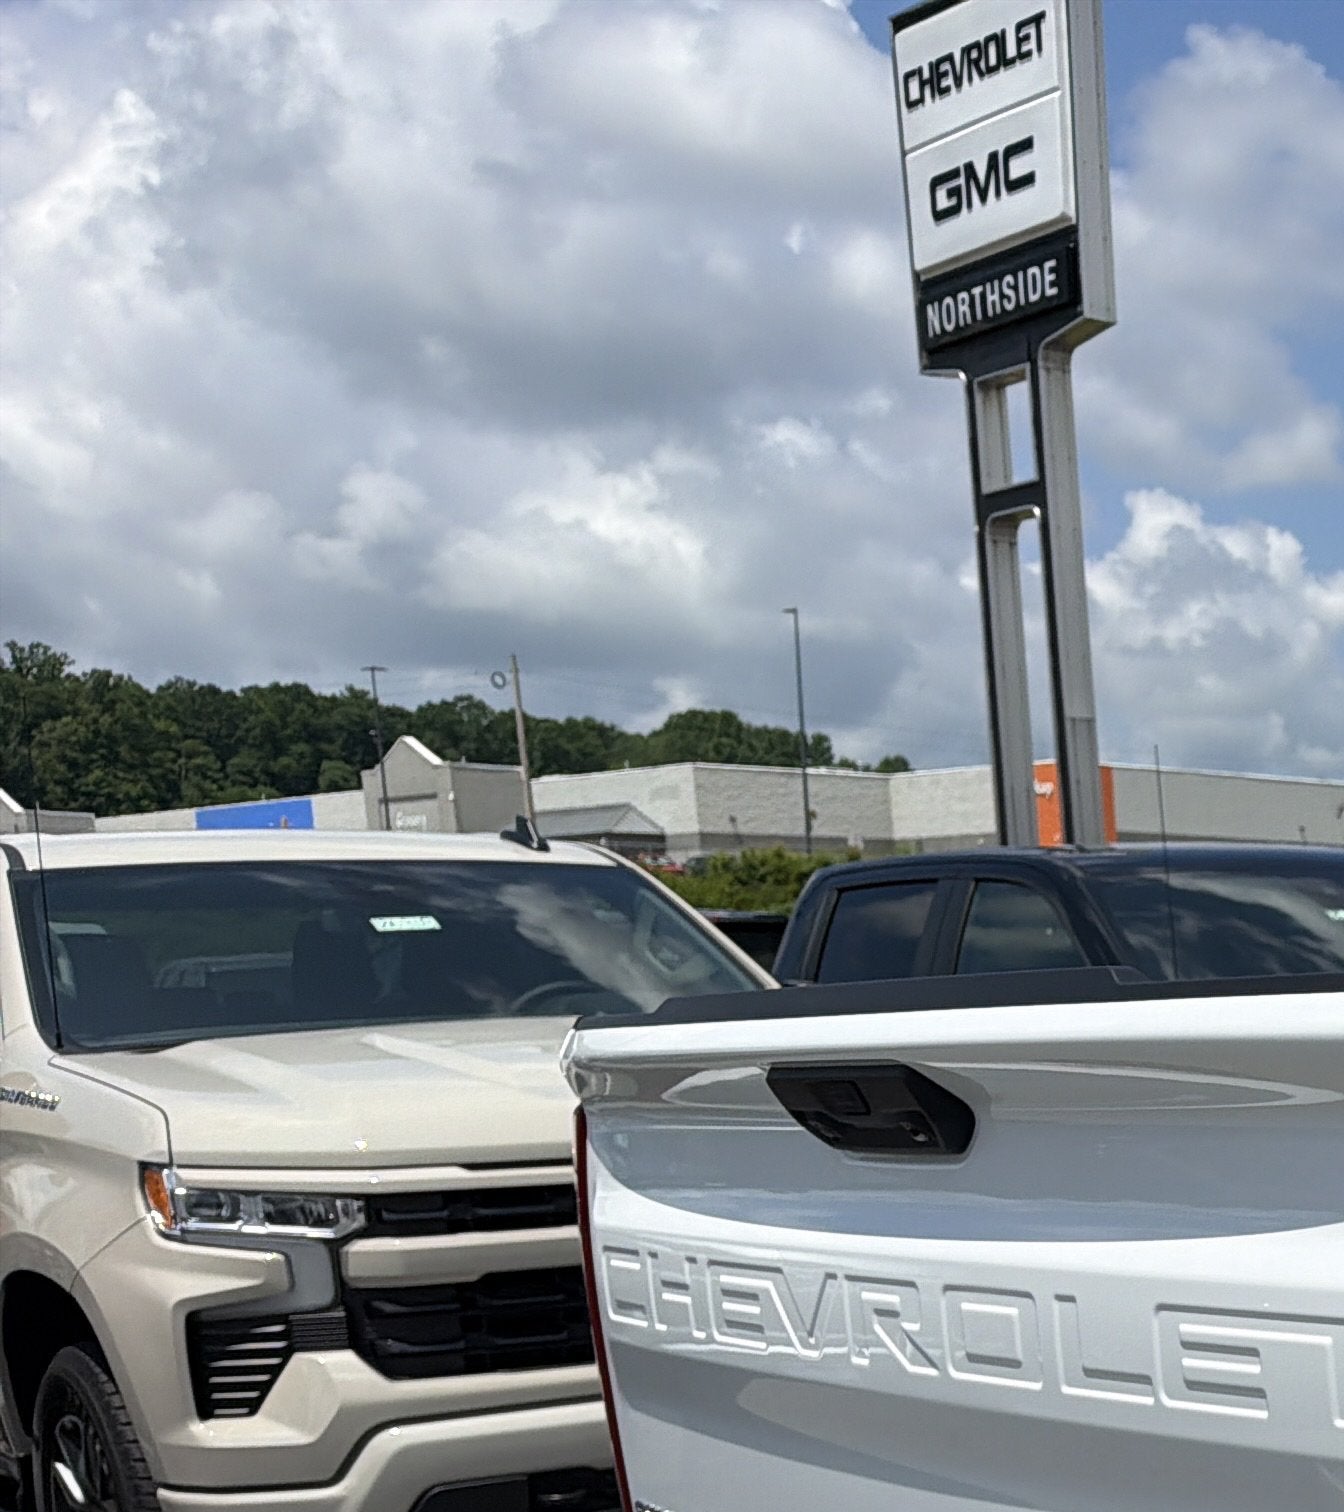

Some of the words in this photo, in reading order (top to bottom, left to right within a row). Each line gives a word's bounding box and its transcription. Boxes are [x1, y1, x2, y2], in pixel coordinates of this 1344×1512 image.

[903, 10, 1046, 109] CHEVROLET
[929, 135, 1036, 222] GMC
[926, 258, 1059, 338] NORTHSIDE
